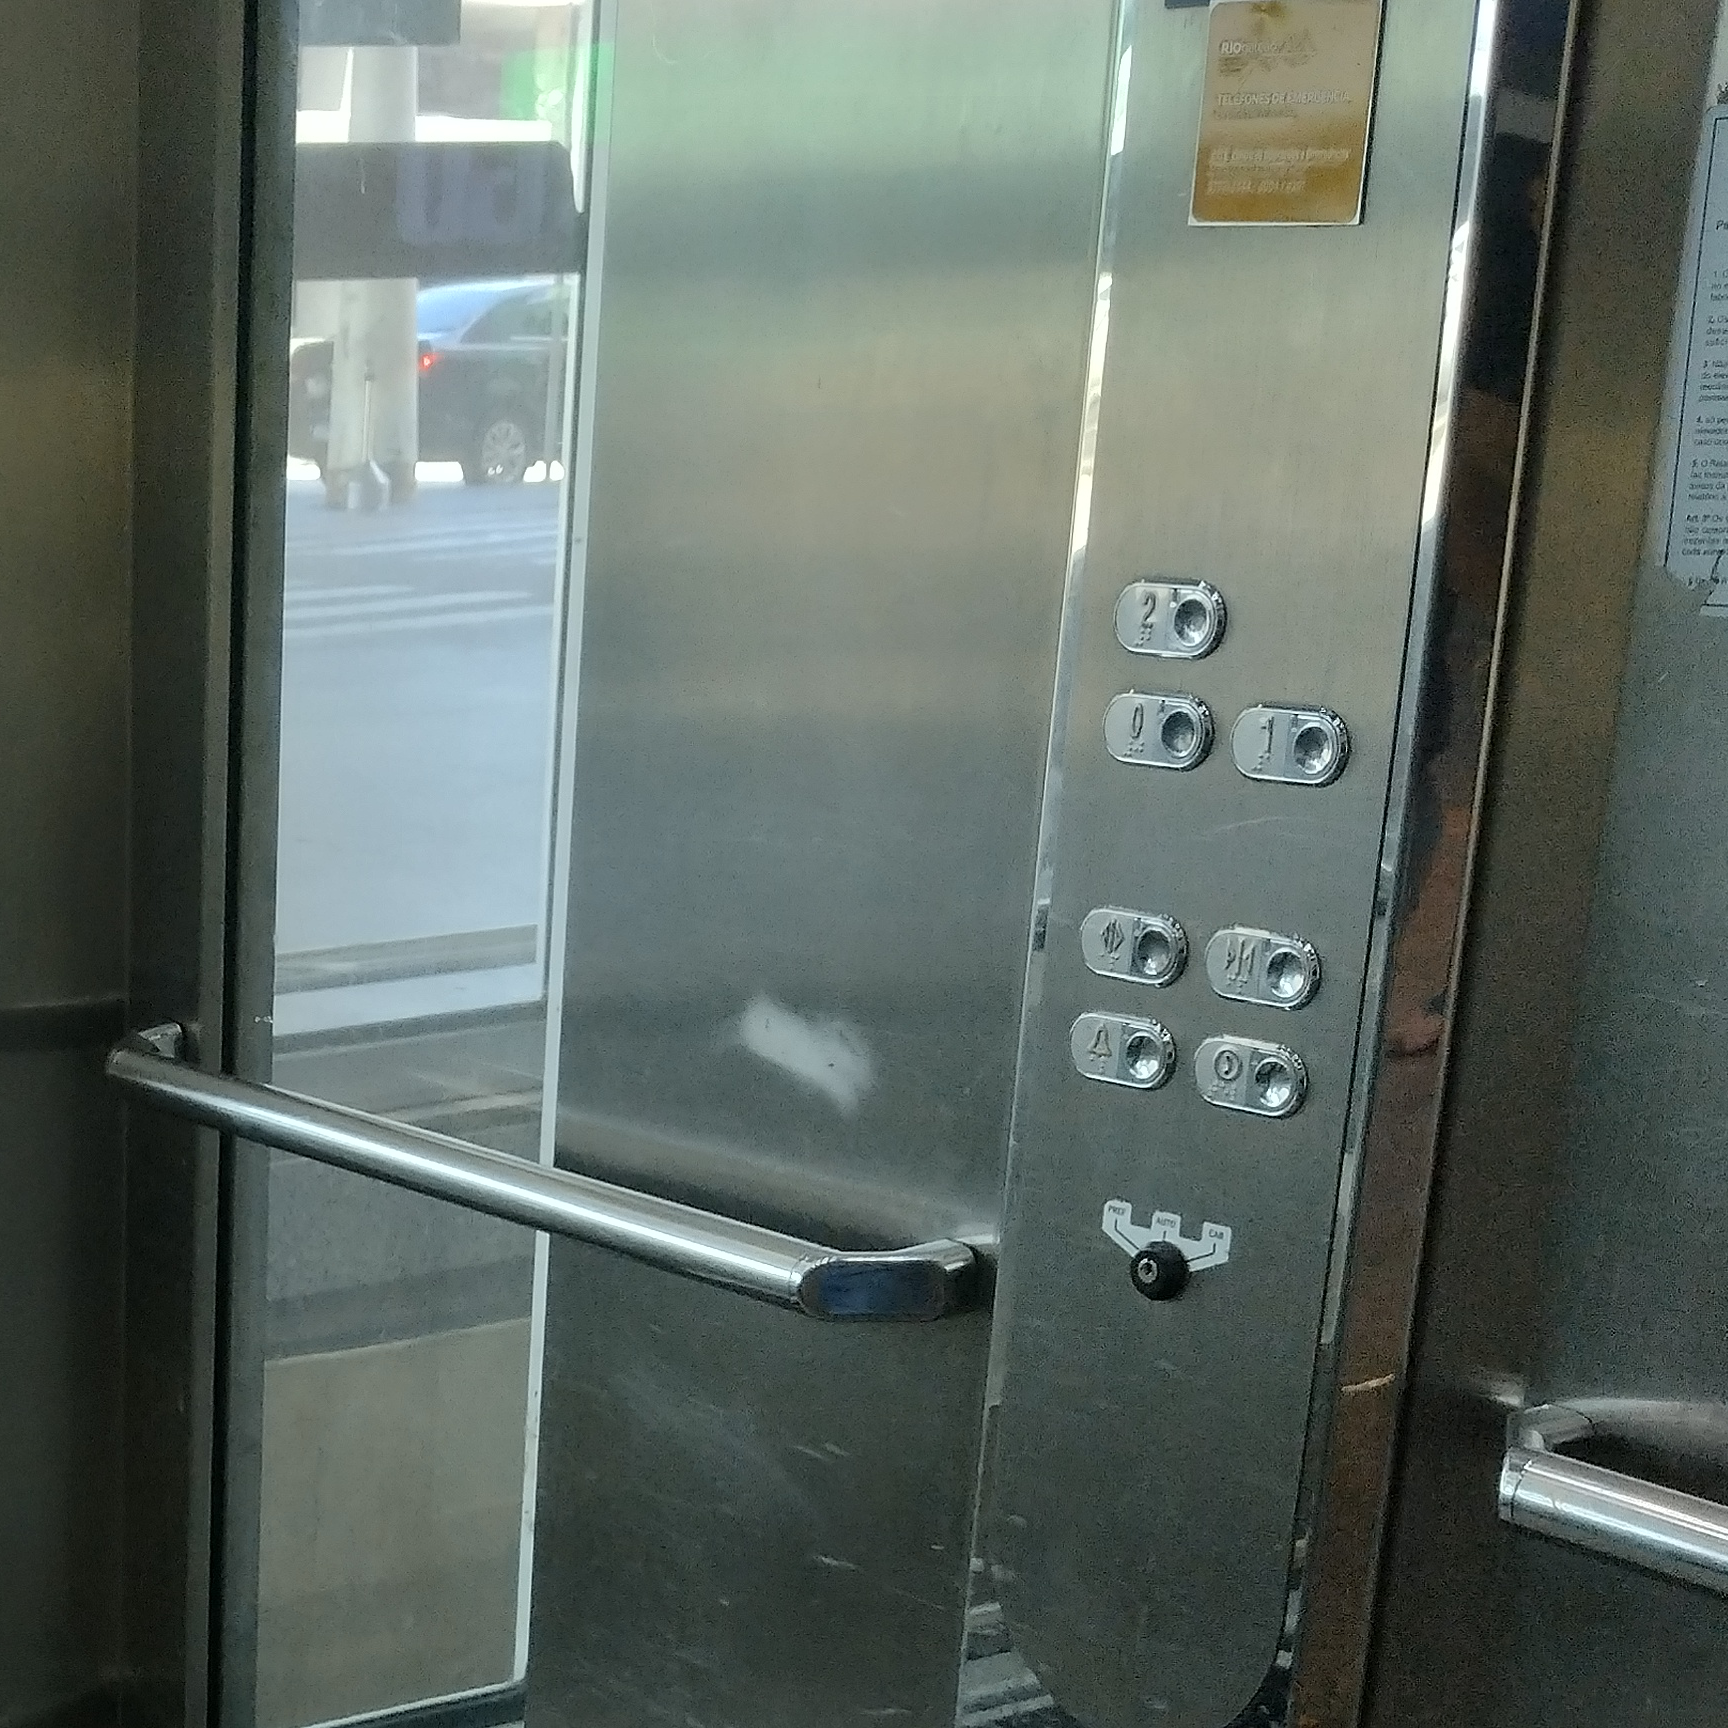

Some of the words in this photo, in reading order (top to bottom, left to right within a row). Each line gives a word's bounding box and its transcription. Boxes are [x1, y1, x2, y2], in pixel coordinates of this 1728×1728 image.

[1141, 590, 1157, 623] 2
[1260, 715, 1274, 753] 1
[1155, 1216, 1177, 1229] AUTO
